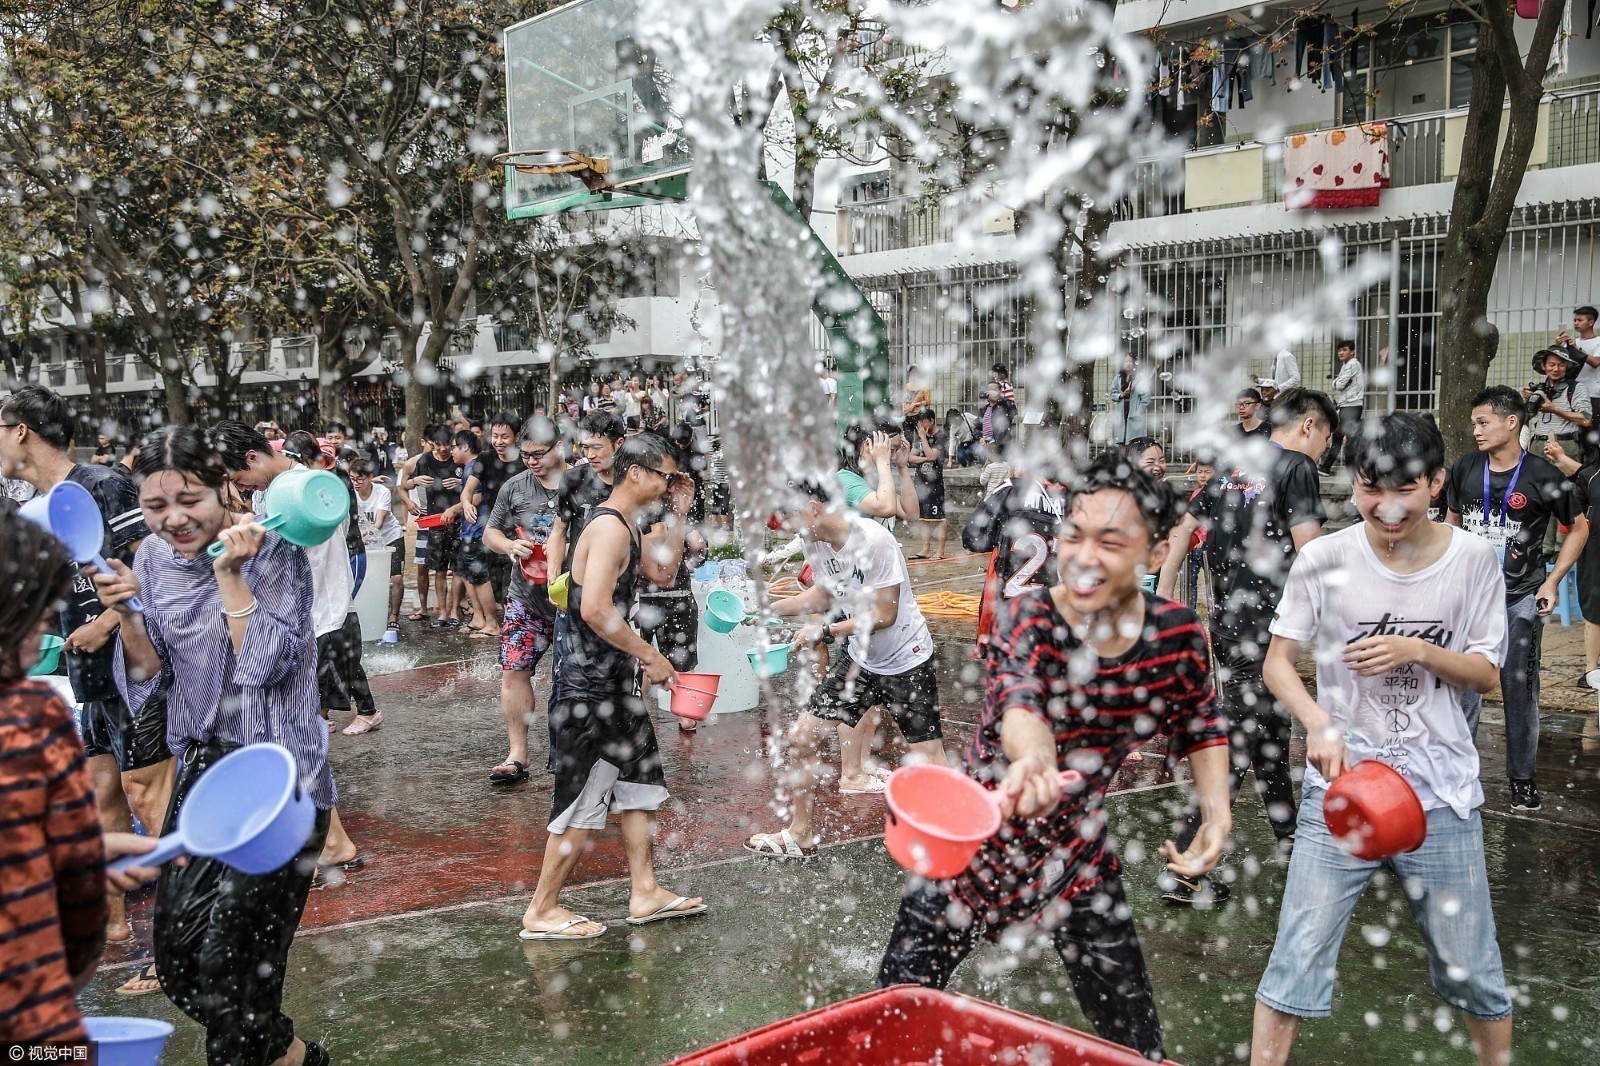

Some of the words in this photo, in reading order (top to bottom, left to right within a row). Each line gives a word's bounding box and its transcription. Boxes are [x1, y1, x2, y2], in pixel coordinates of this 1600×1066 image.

[931, 505, 938, 515] 3
[1004, 533, 1058, 598] 2
[1382, 676, 1418, 691] 平和
